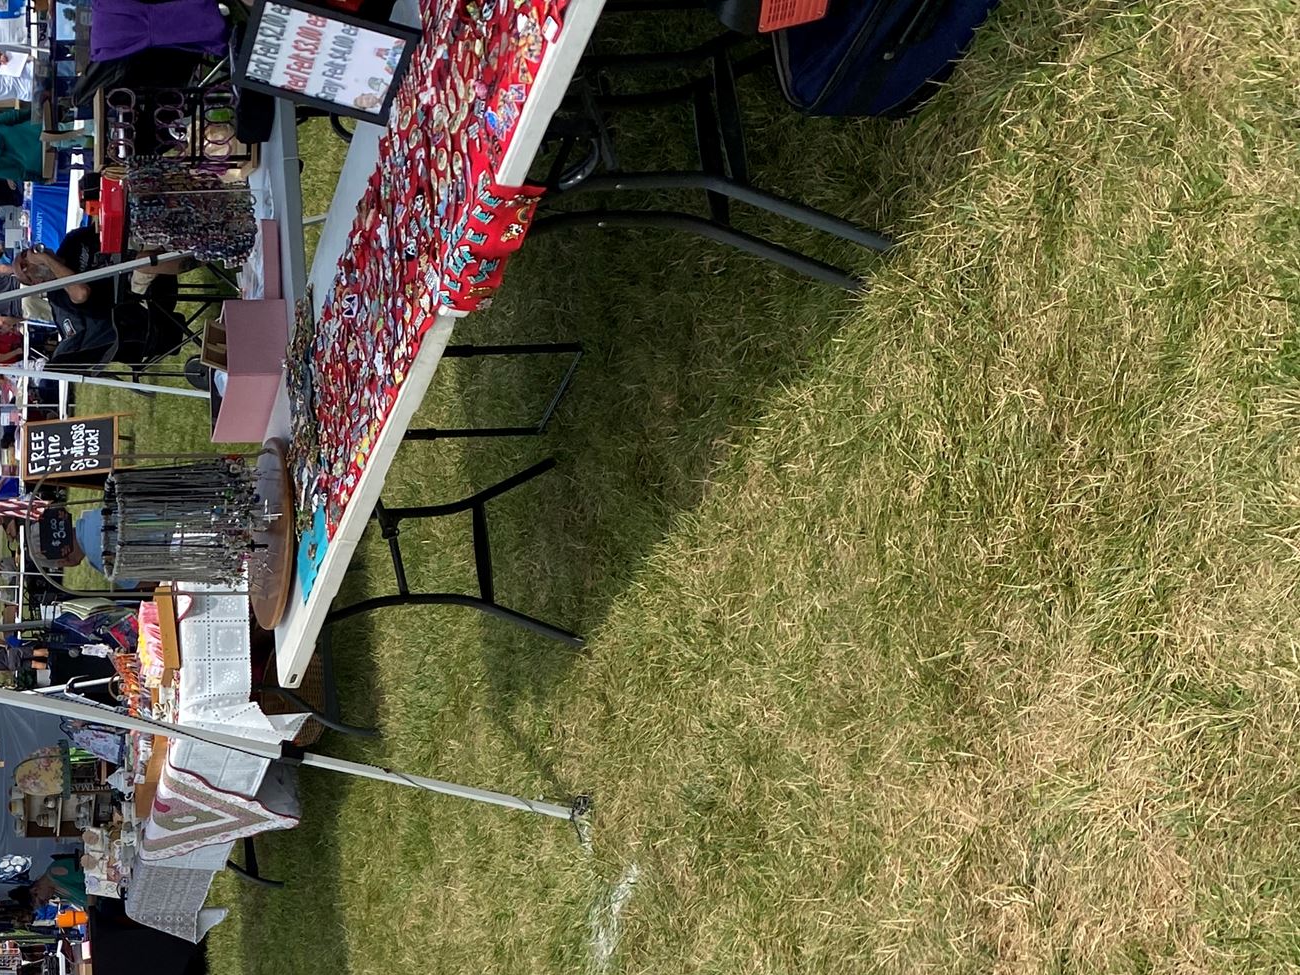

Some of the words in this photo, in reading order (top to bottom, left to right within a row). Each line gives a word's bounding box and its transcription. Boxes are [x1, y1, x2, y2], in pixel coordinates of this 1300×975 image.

[259, 14, 287, 40] $2.00
[252, 40, 280, 59] Felt
[293, 27, 321, 55] $3.00
[327, 36, 354, 61] $4.00
[286, 53, 315, 74] Felt
[322, 61, 347, 80] Felt
[28, 432, 45, 474] FREE
